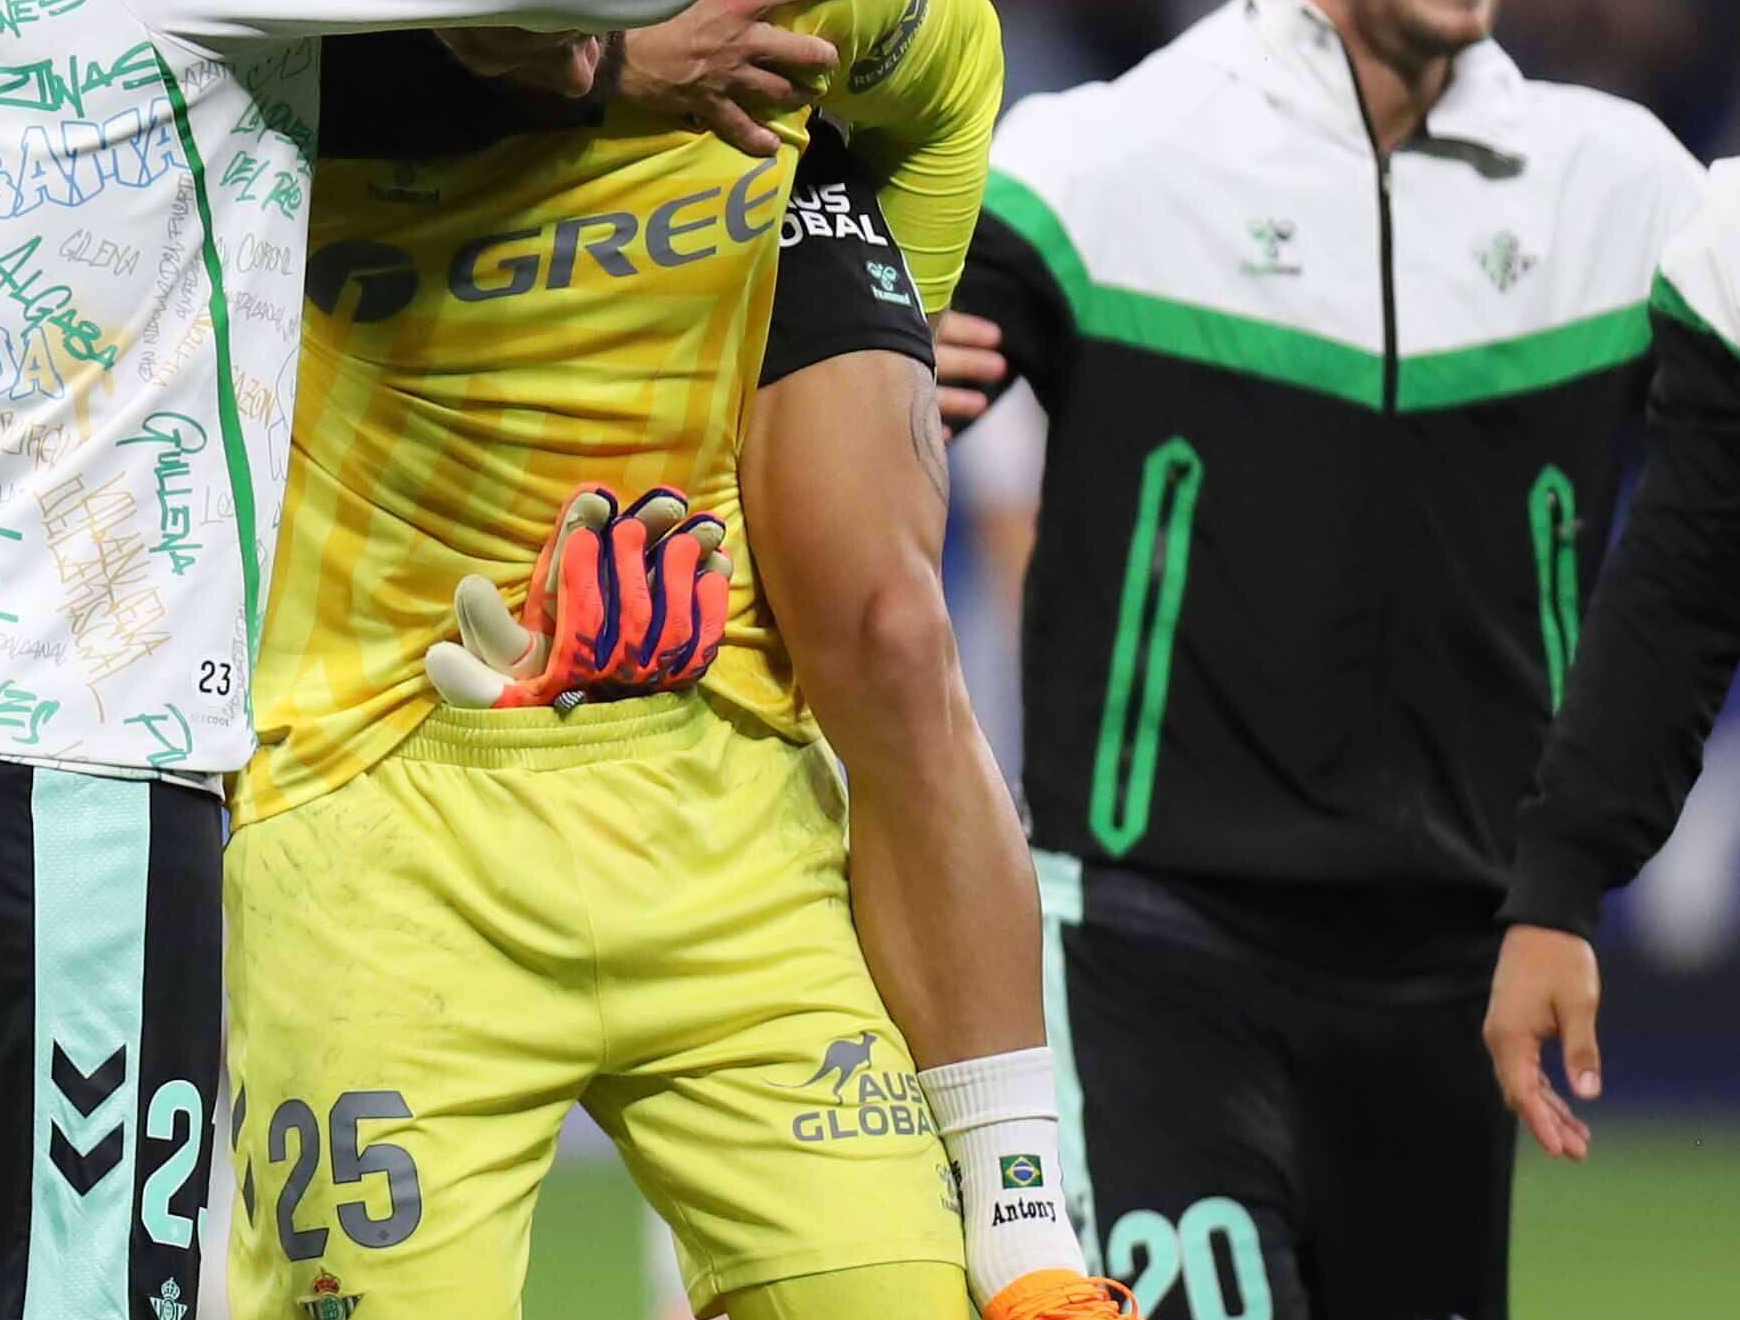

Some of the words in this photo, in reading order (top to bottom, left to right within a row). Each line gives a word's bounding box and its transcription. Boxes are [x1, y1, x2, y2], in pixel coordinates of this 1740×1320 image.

[787, 183, 851, 212] US
[448, 157, 778, 303] GREE
[779, 212, 888, 246] OBAL
[873, 287, 910, 307] hummel
[198, 659, 232, 696] 23
[791, 1104, 936, 1142] GLOBA
[141, 1079, 211, 1250] 2
[267, 1088, 423, 1261] 25
[992, 1197, 1057, 1226] Antony
